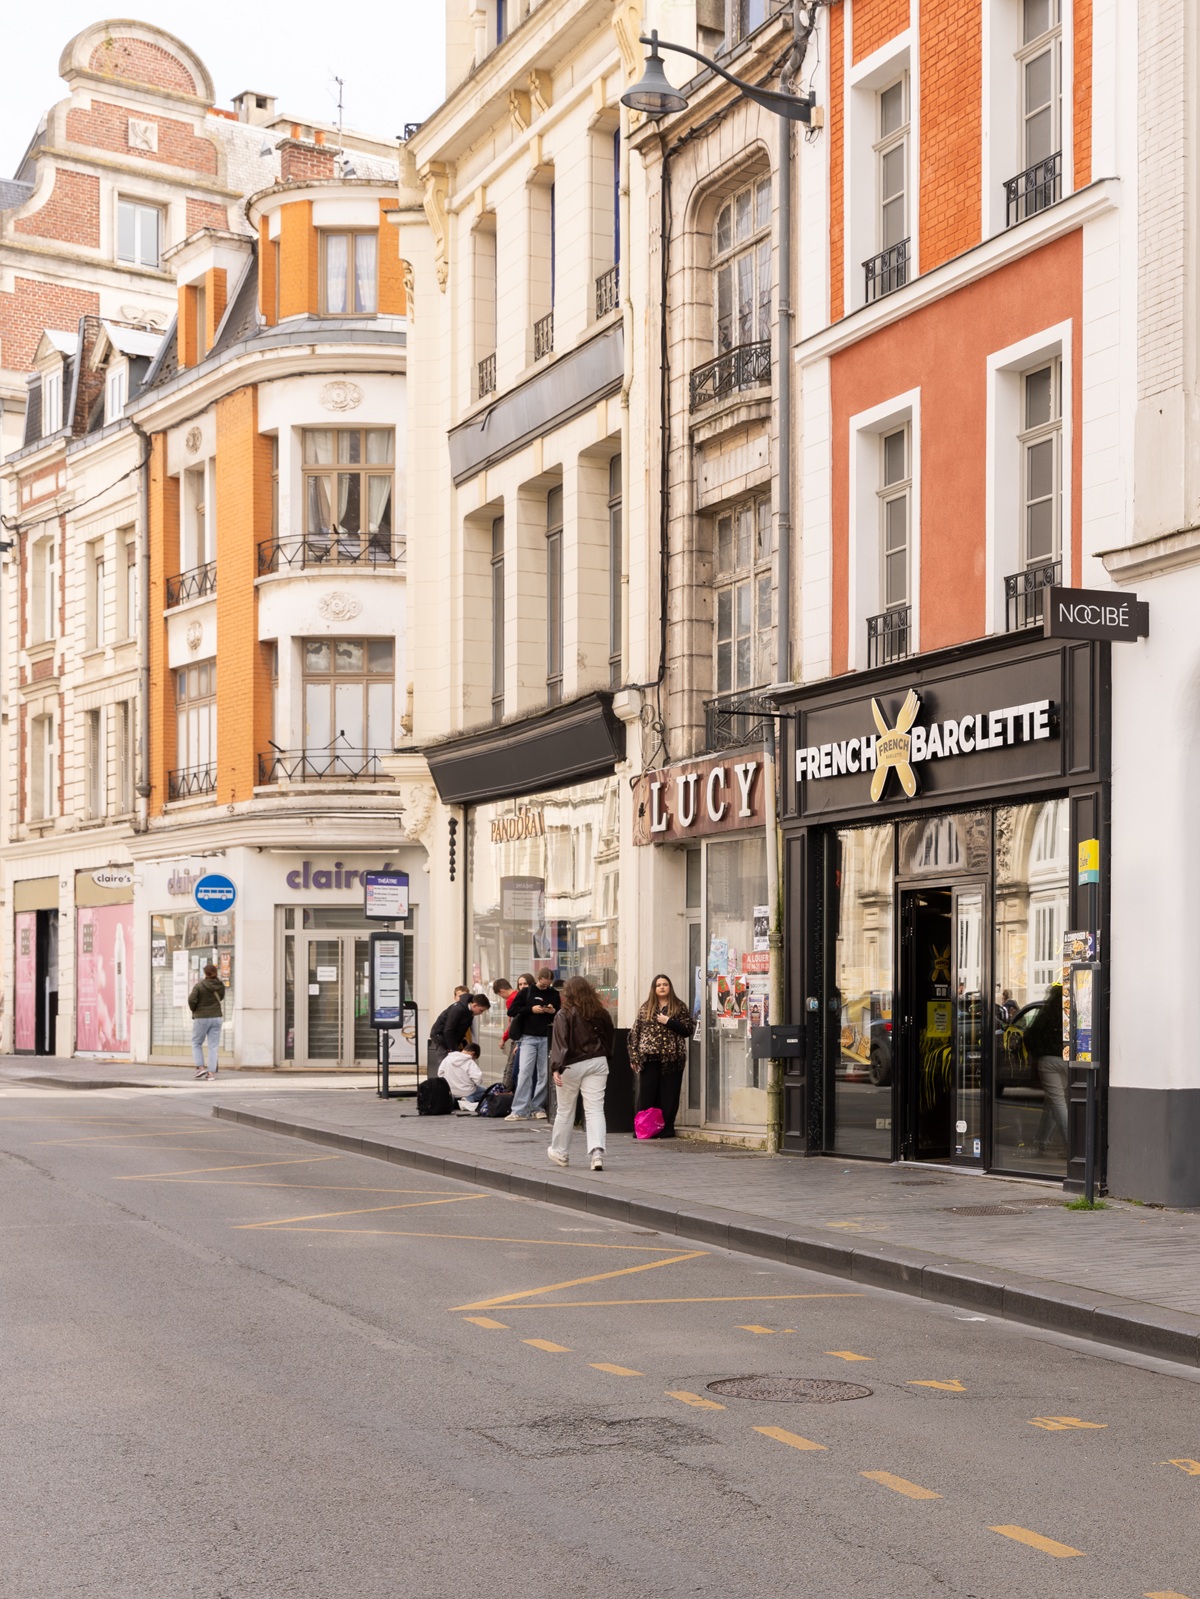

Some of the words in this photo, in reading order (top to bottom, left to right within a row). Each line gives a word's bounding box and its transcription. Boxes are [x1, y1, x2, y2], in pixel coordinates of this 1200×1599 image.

[1059, 602, 1130, 628] NOCIBÉ
[796, 734, 877, 782] FRENCH
[910, 699, 1051, 763] BARCLETTE
[878, 738, 910, 757] FRENCH
[650, 761, 759, 833] LUCY
[490, 811, 541, 844] PANDORA
[97, 874, 132, 884] claire's
